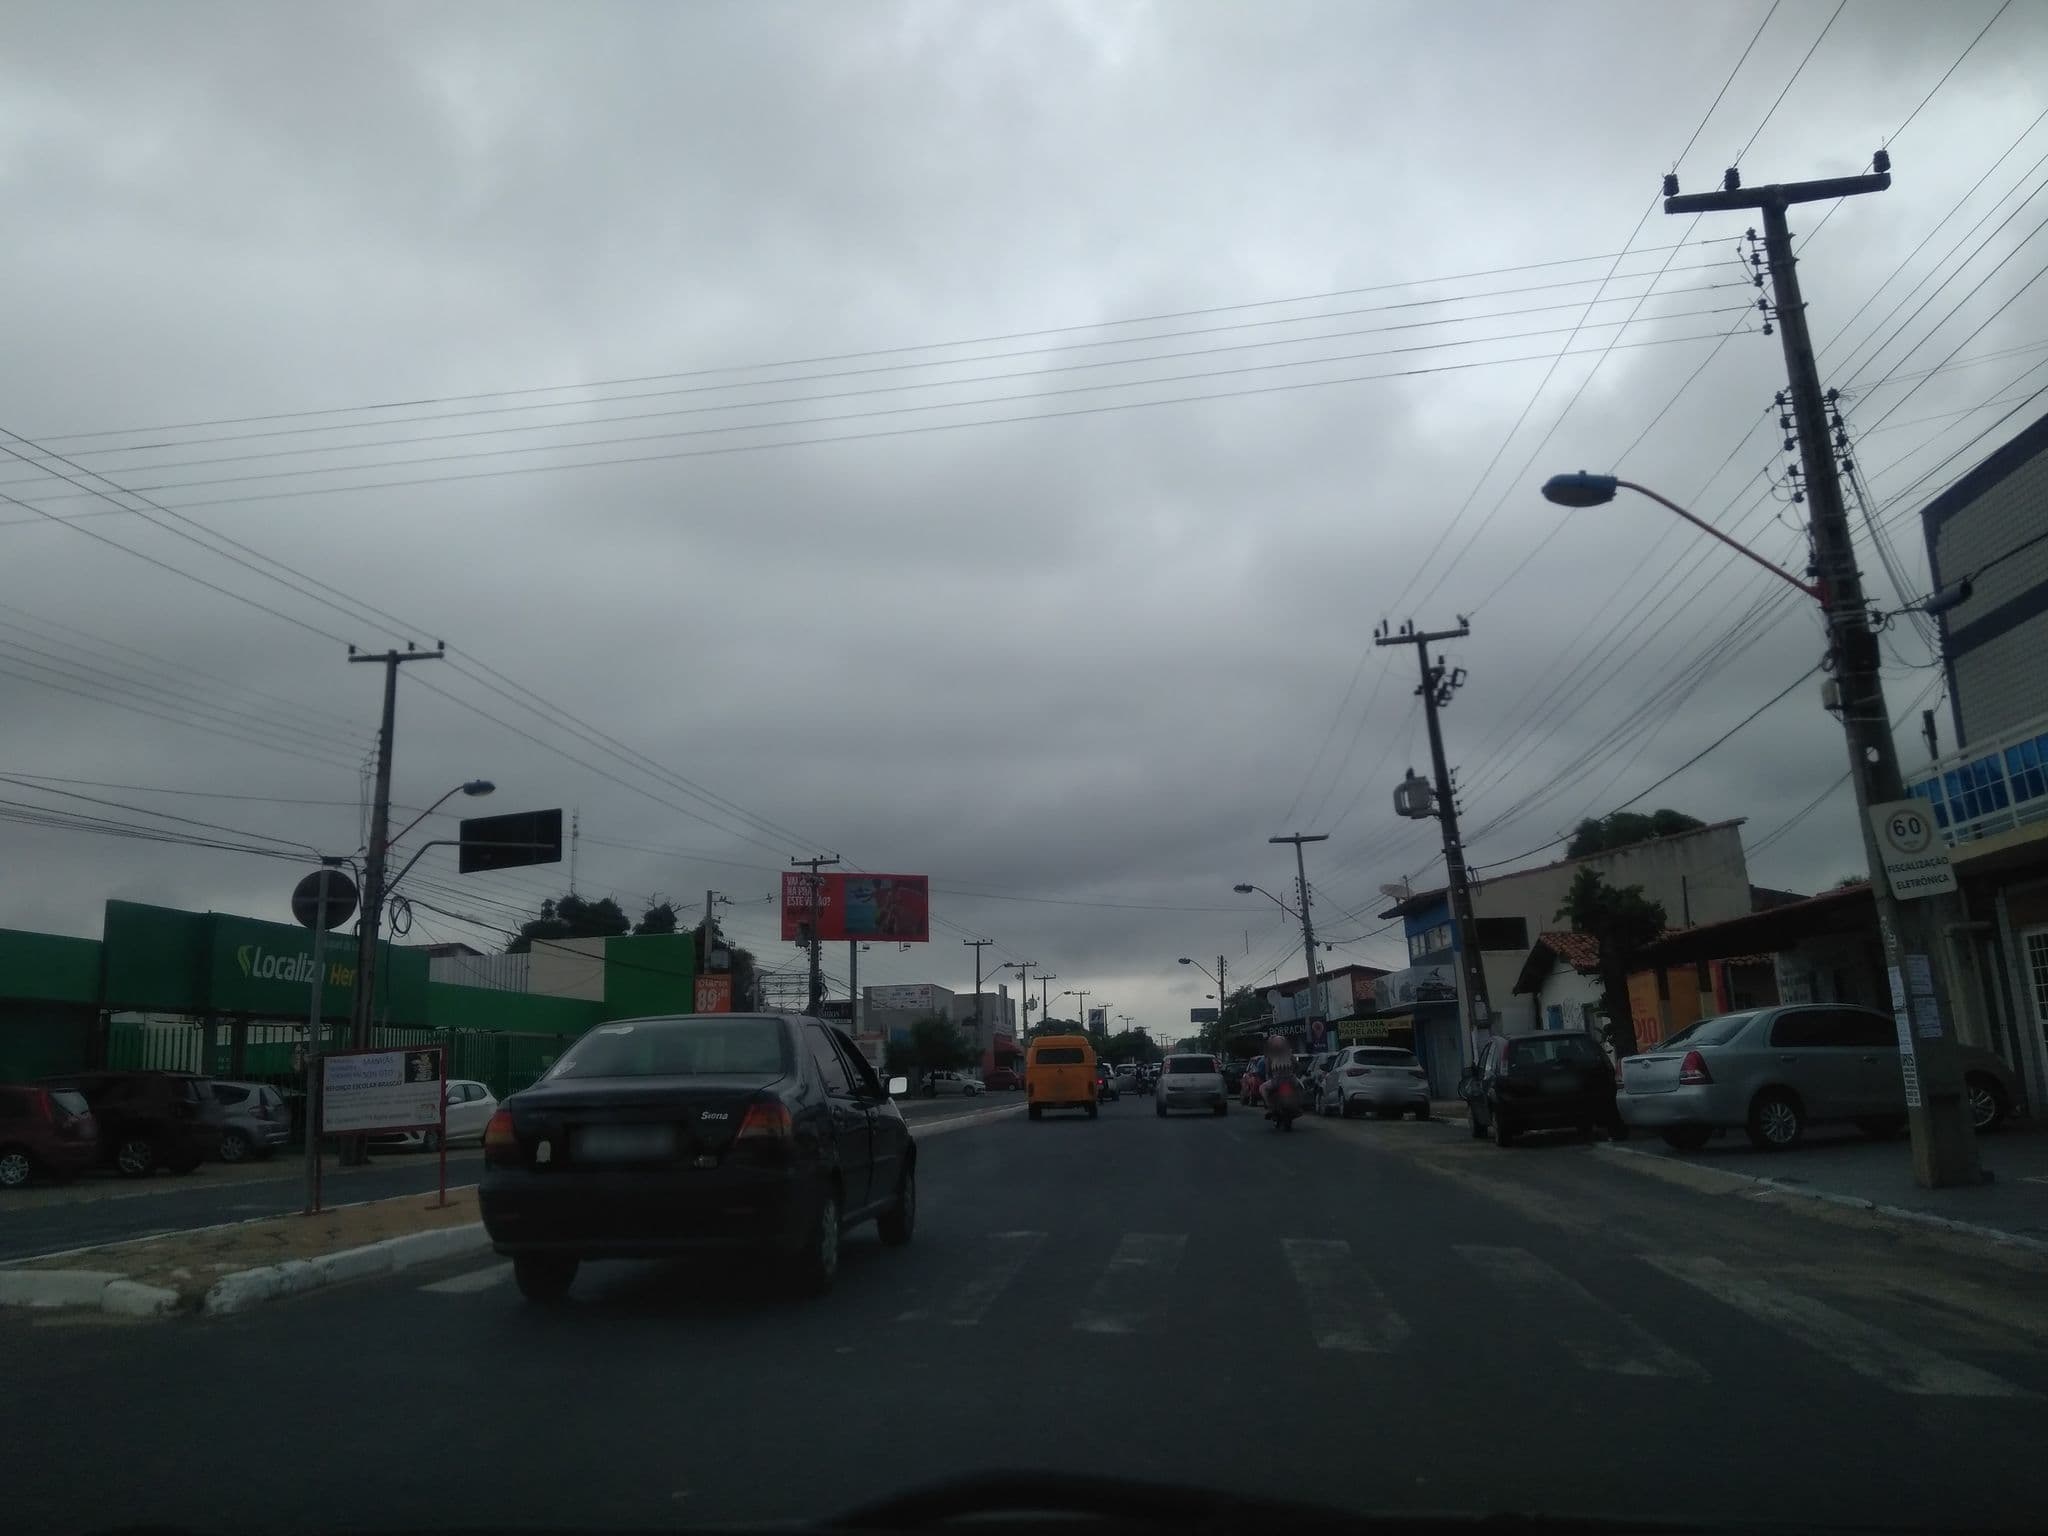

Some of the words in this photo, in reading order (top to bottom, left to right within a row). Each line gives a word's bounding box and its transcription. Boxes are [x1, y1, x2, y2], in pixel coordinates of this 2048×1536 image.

[1893, 817, 1921, 837] 60
[1887, 856, 1950, 873] FISCALIZAÇÃO
[1896, 873, 1950, 890] ELETRÔNICA
